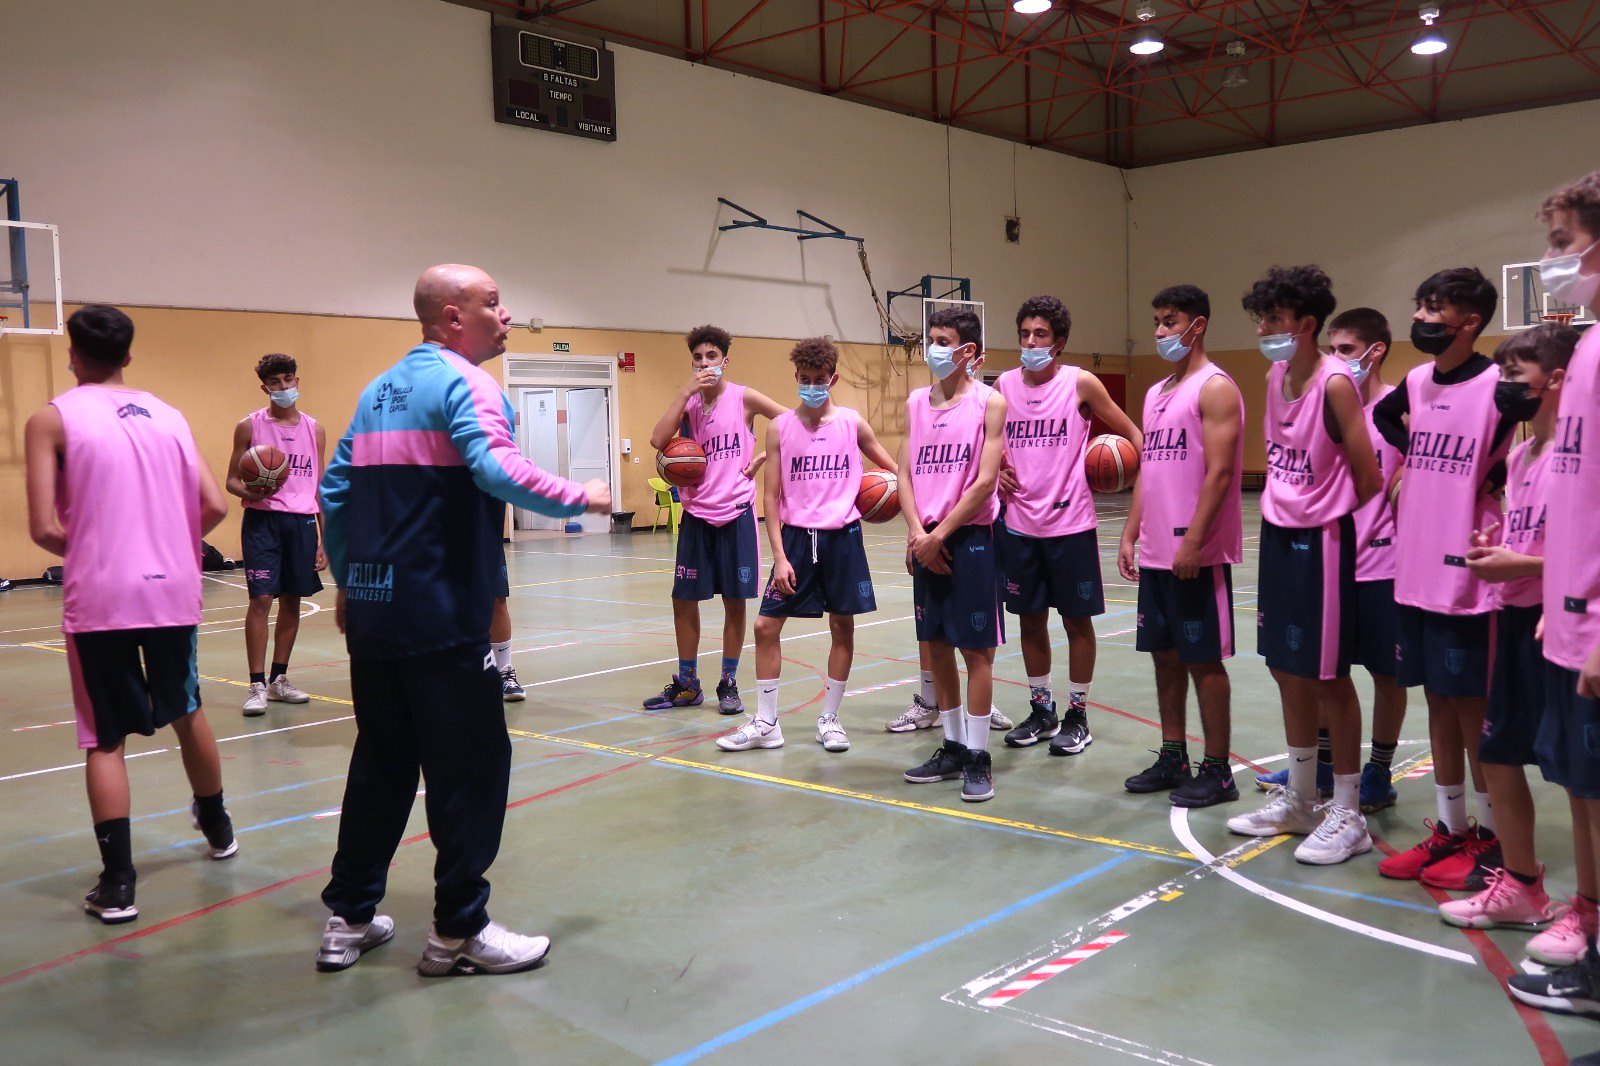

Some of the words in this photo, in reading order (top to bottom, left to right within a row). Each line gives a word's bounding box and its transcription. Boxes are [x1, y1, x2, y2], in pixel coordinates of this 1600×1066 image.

[550, 74, 578, 87] FALTAS
[549, 90, 573, 102] TIEMPO
[515, 109, 540, 122] LOCAL
[578, 122, 612, 135] VISITANTE
[553, 343, 570, 351] SALIDA
[1005, 418, 1068, 439] MELILLA
[1009, 438, 1068, 449] ALONCESTO
[1142, 427, 1188, 452] ELILLA
[1266, 439, 1314, 474] ELILLA
[791, 453, 850, 474] MELILLA
[790, 470, 850, 482] BALONCESTO
